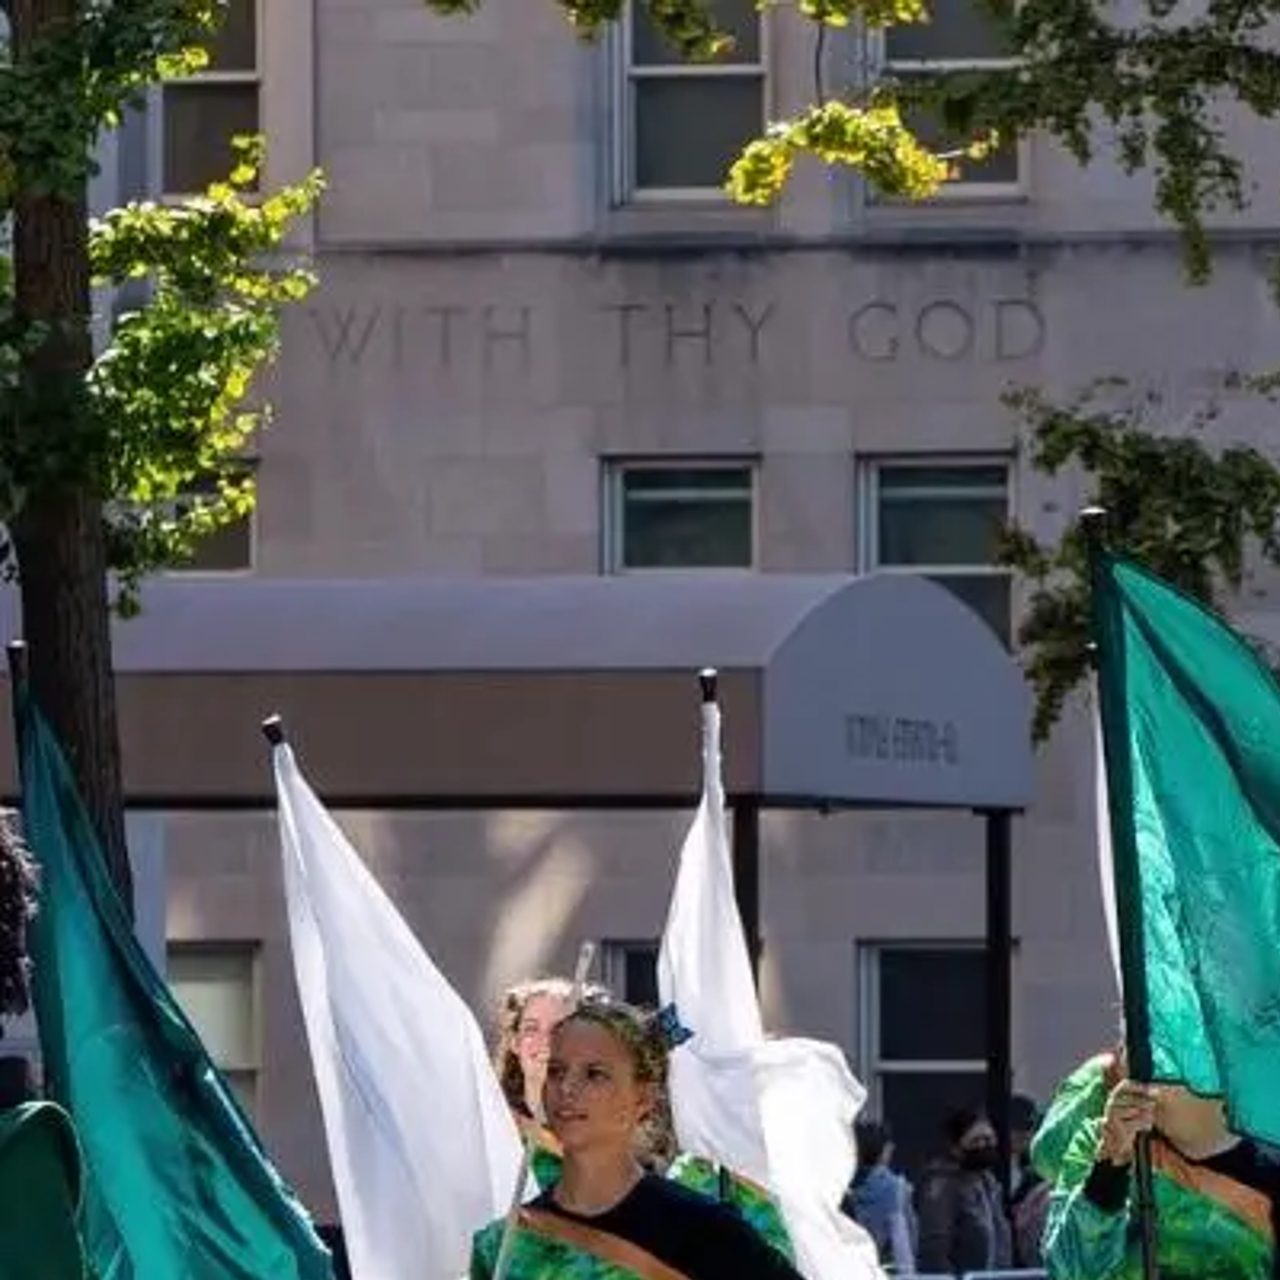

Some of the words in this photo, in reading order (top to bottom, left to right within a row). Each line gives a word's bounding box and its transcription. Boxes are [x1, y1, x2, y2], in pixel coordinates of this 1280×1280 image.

[307, 302, 533, 372] WITH
[603, 301, 776, 368] THY
[847, 300, 1047, 362] GOD
